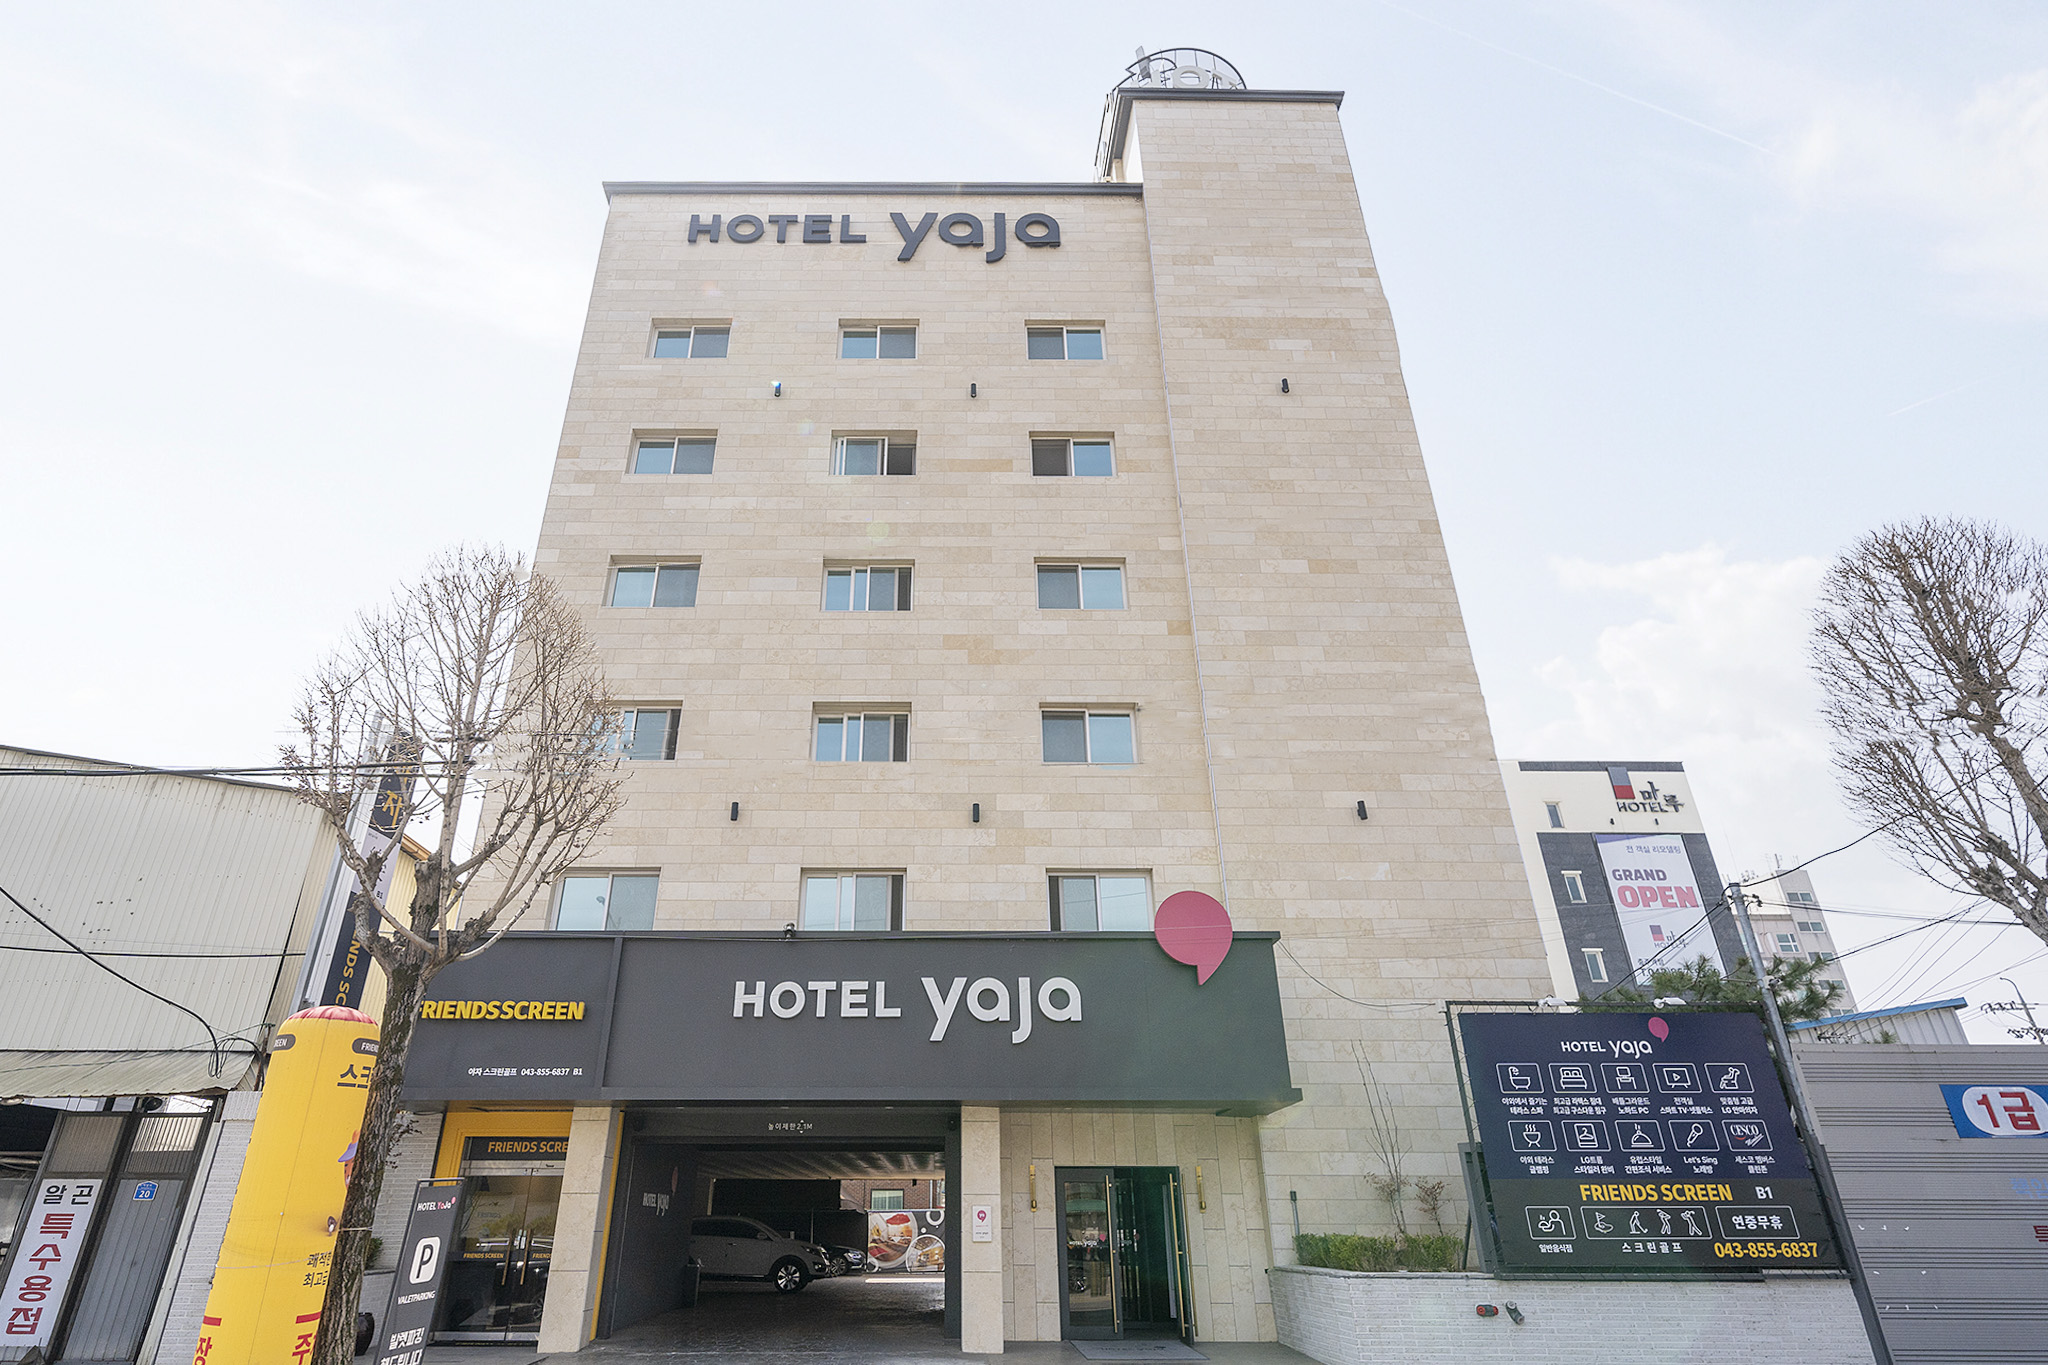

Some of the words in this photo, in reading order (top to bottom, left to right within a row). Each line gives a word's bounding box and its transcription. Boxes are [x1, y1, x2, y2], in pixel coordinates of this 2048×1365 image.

[687, 213, 867, 244] HOTEL
[889, 212, 1061, 263] yaja
[1617, 802, 1668, 812] HOTEL
[1612, 869, 1667, 881] GRAND
[1617, 886, 1700, 908] OPEN
[732, 980, 902, 1019] HOTEL
[920, 976, 1083, 1044] yaja
[1560, 1041, 1606, 1052] HOTEL
[1608, 1040, 1653, 1059] yaja
[468, 1068, 481, 1076] 야자
[483, 1068, 517, 1077] 스크린골프
[521, 1068, 570, 1076] 043-855-6837
[572, 1068, 583, 1076] B1
[1976, 1092, 2041, 1131] 1급
[1730, 1124, 1759, 1136] CESCO
[488, 1141, 538, 1153] FRIENDS
[1702, 1156, 1718, 1165] Sing
[139, 1190, 150, 1198] 20
[1580, 1184, 1658, 1201] FRIENDS
[1661, 1184, 1733, 1201] SCREEN
[1755, 1186, 1773, 1199] B1
[417, 1202, 436, 1211] HOTEL
[1732, 1215, 1783, 1230] 연중무휴
[1538, 1244, 1574, 1253] 일반음식점
[1714, 1242, 1818, 1258] 043-855-6837
[389, 1327, 425, 1351] 발렛파킹
